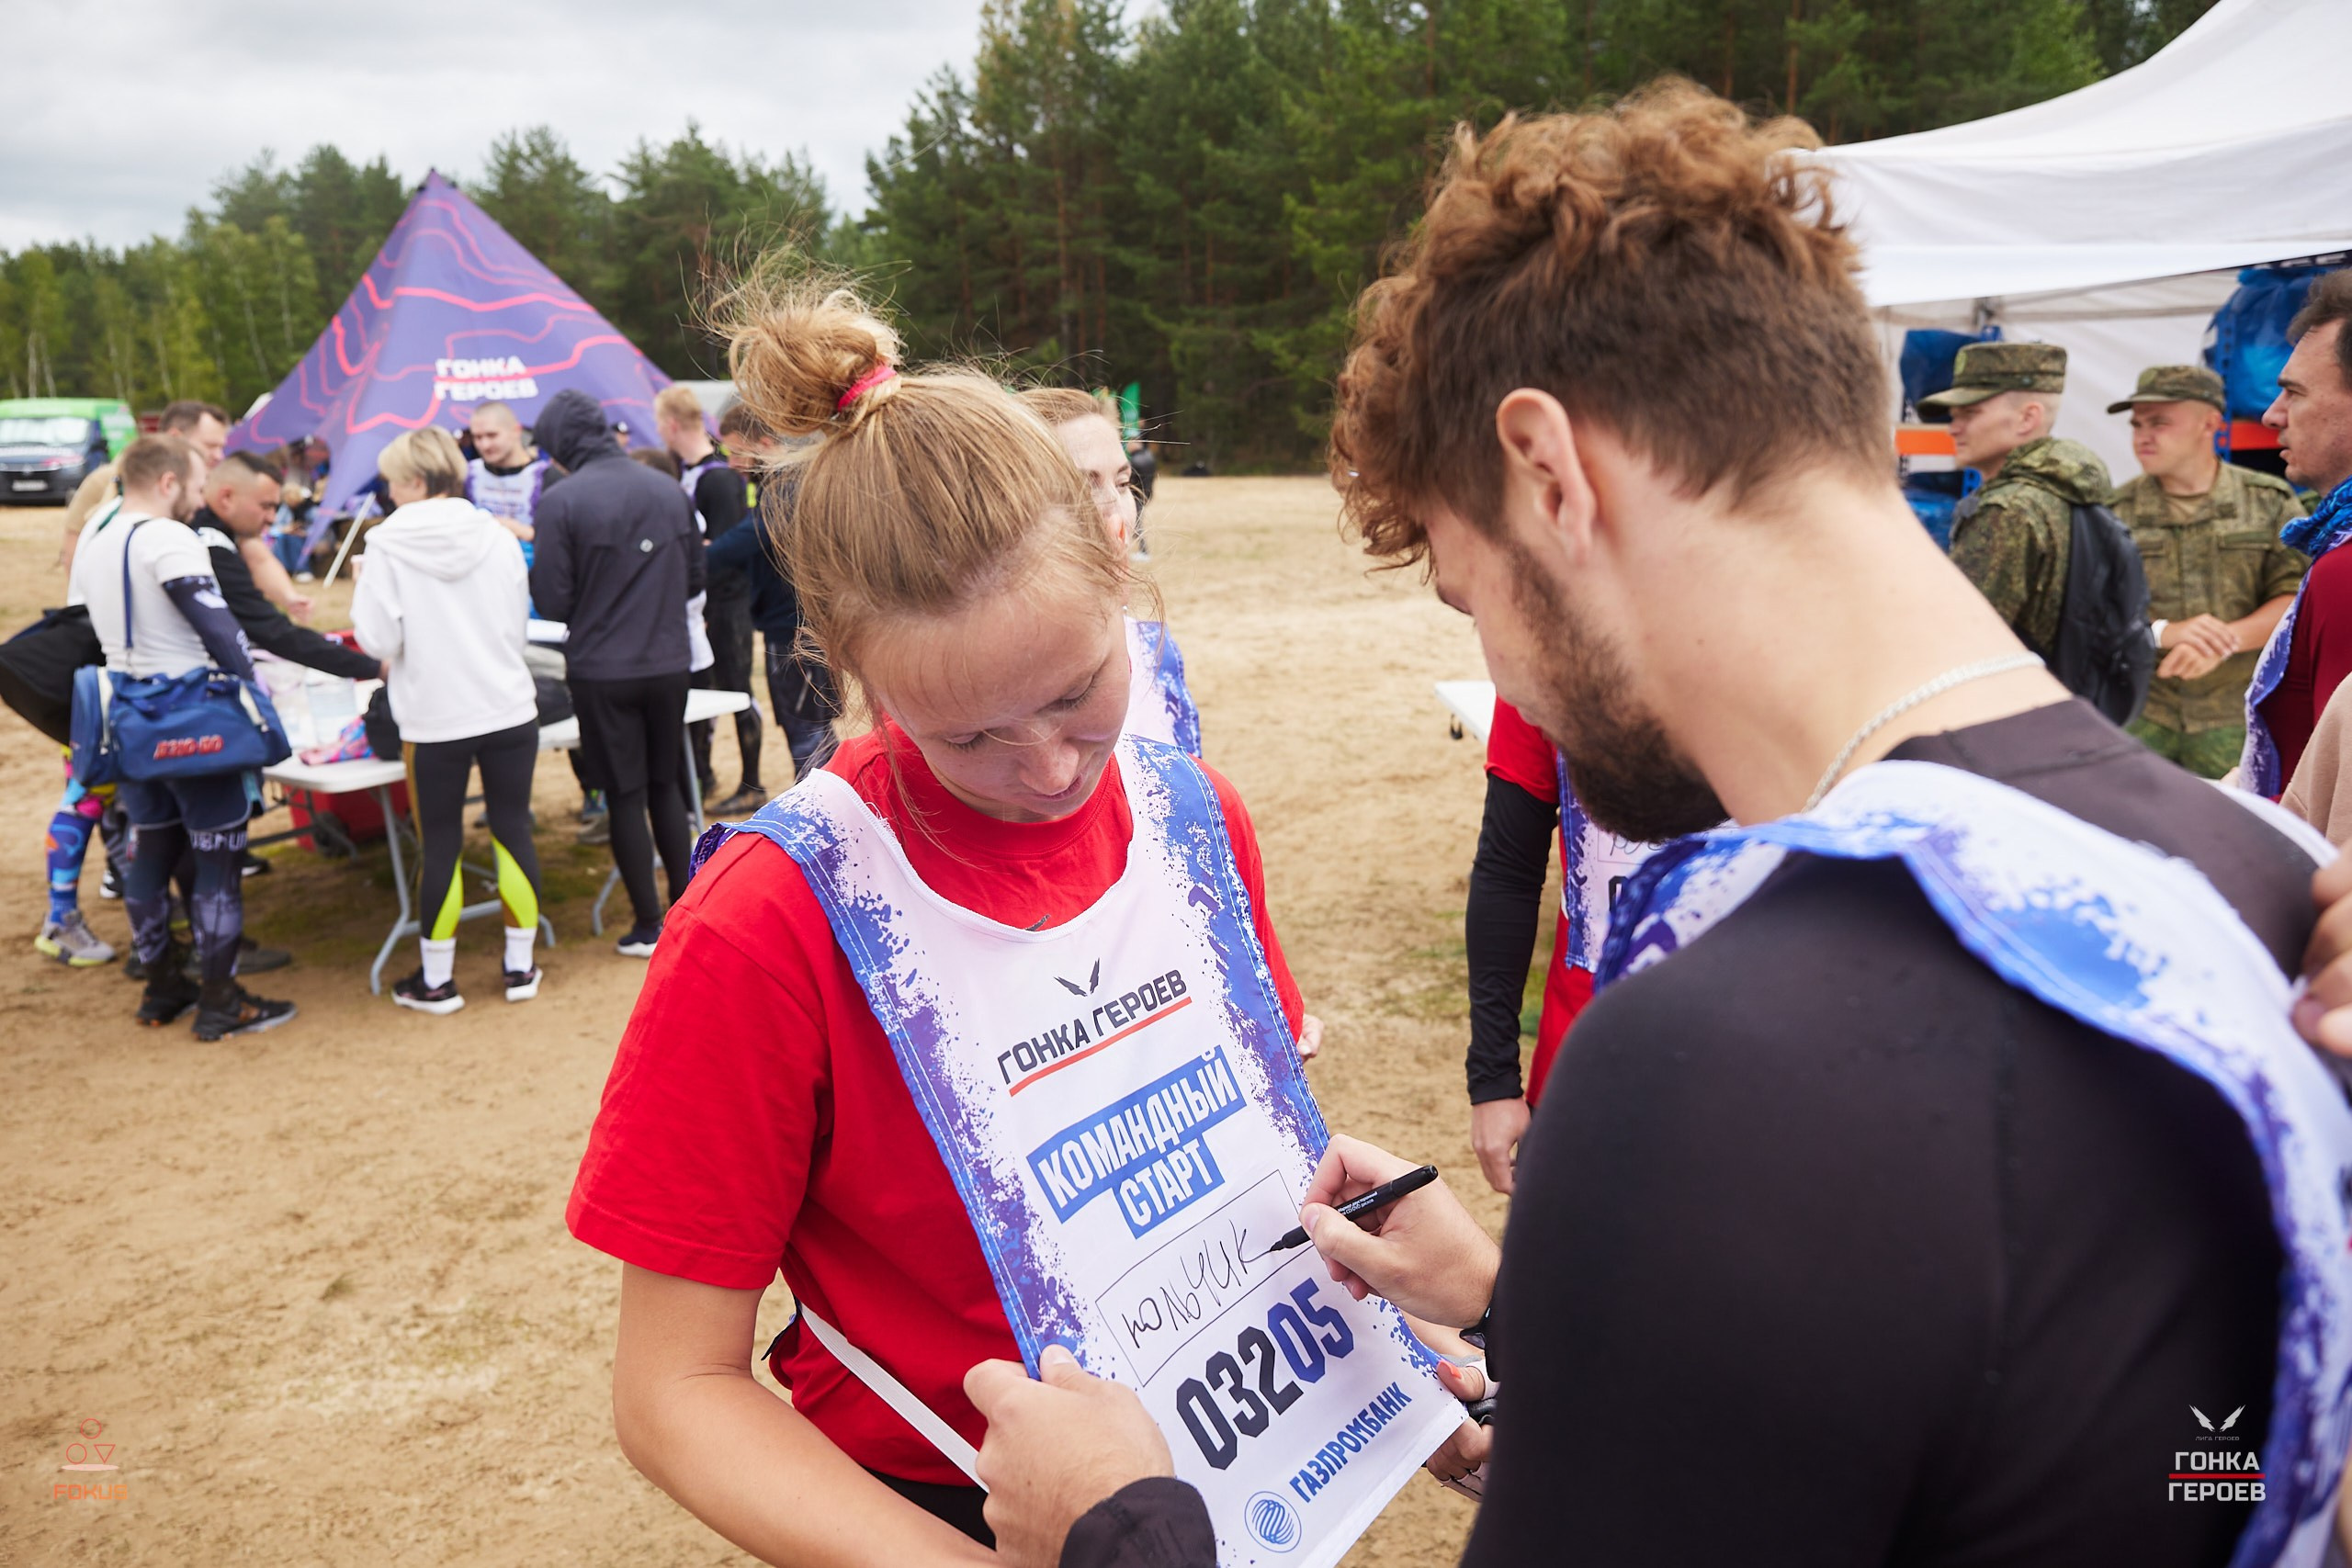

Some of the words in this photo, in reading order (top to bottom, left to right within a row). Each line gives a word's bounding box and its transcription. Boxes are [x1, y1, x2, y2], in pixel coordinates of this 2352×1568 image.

[434, 378, 538, 401] ГЕРОЕВ
[435, 355, 527, 378] ГОНКА
[998, 1019, 1091, 1085] ГОНКА
[1092, 969, 1187, 1037] ГЕРОЕВ
[1037, 1048, 1238, 1209] КОМАНДНЫЙ
[1119, 1138, 1213, 1226] СТАРТ
[1176, 1277, 1354, 1471] 03205
[1289, 1382, 1412, 1503] ГАЗПРОМБАНК
